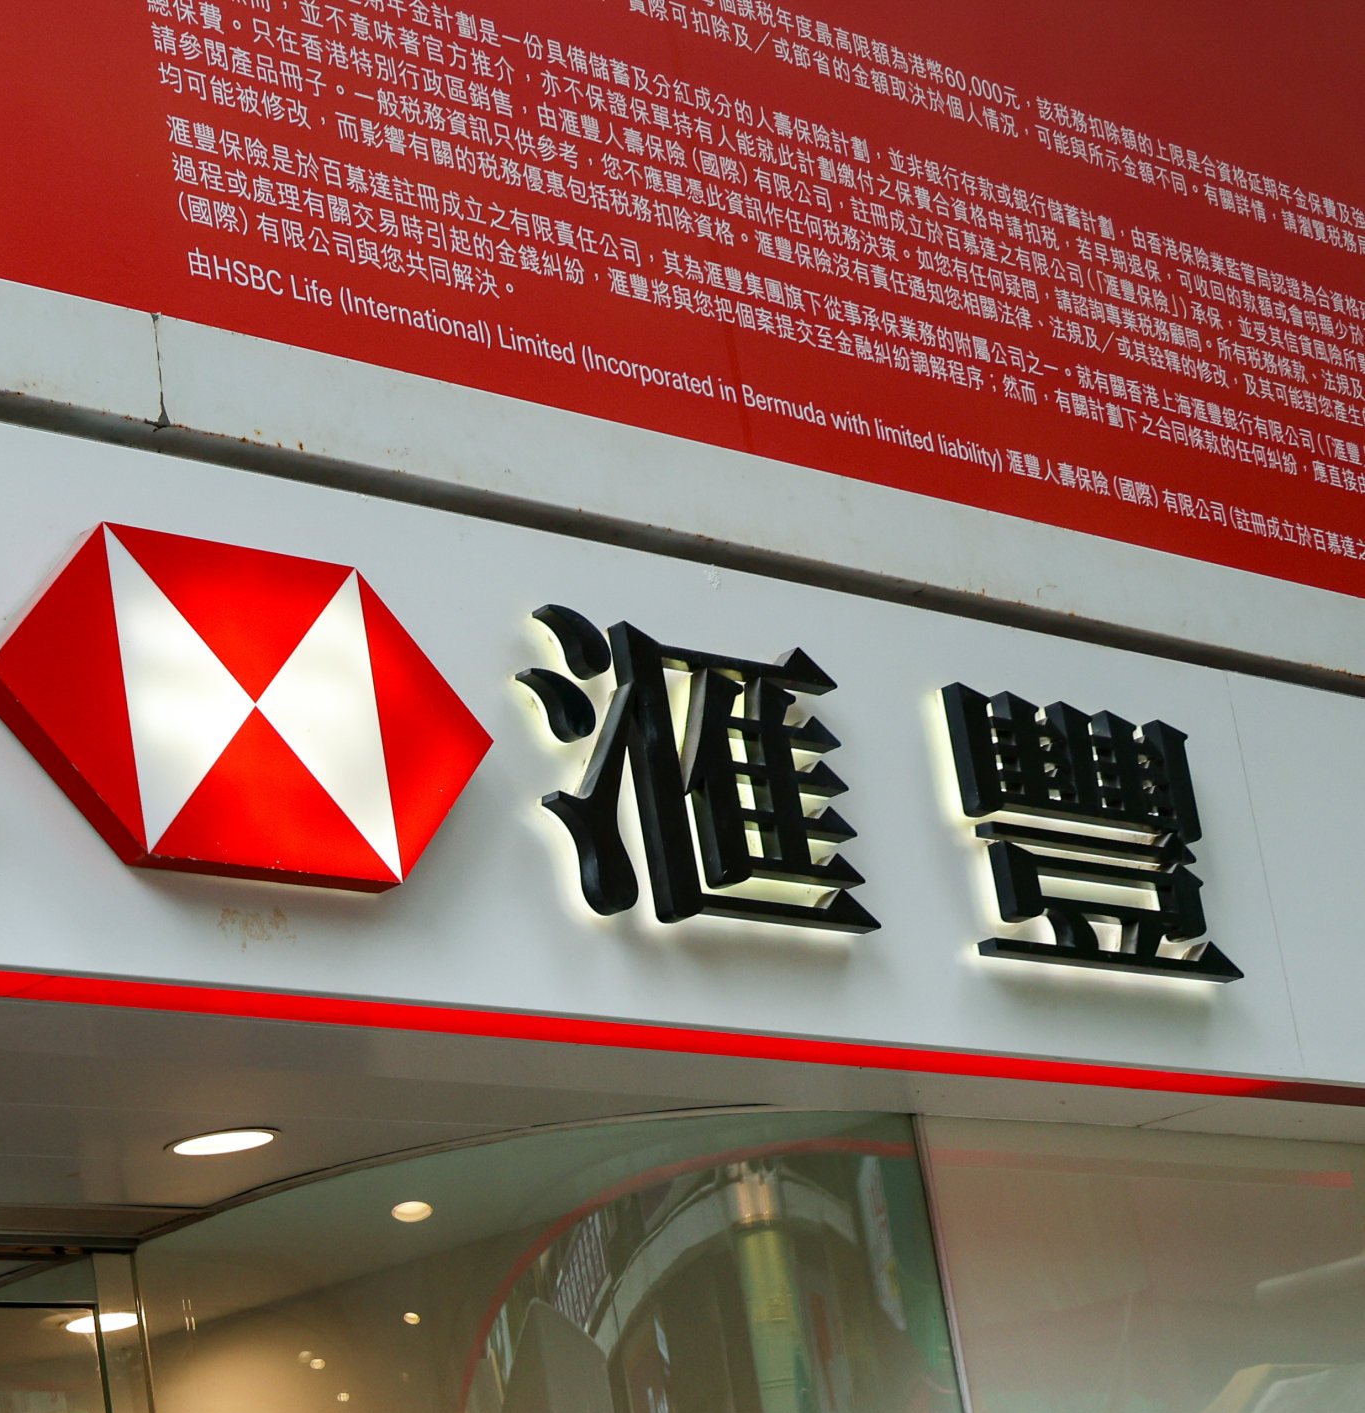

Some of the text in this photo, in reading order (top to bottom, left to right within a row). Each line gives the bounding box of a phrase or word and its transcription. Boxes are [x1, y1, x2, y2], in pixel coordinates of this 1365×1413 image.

[290, 274, 332, 307] Life
[339, 286, 490, 349] (International)
[497, 324, 575, 365] Limited
[581, 344, 714, 397] (Incorporated
[717, 377, 736, 403] in
[741, 383, 826, 427] Bermuda
[830, 411, 870, 437] with
[874, 417, 934, 452] limited
[937, 433, 1002, 473] liability)
